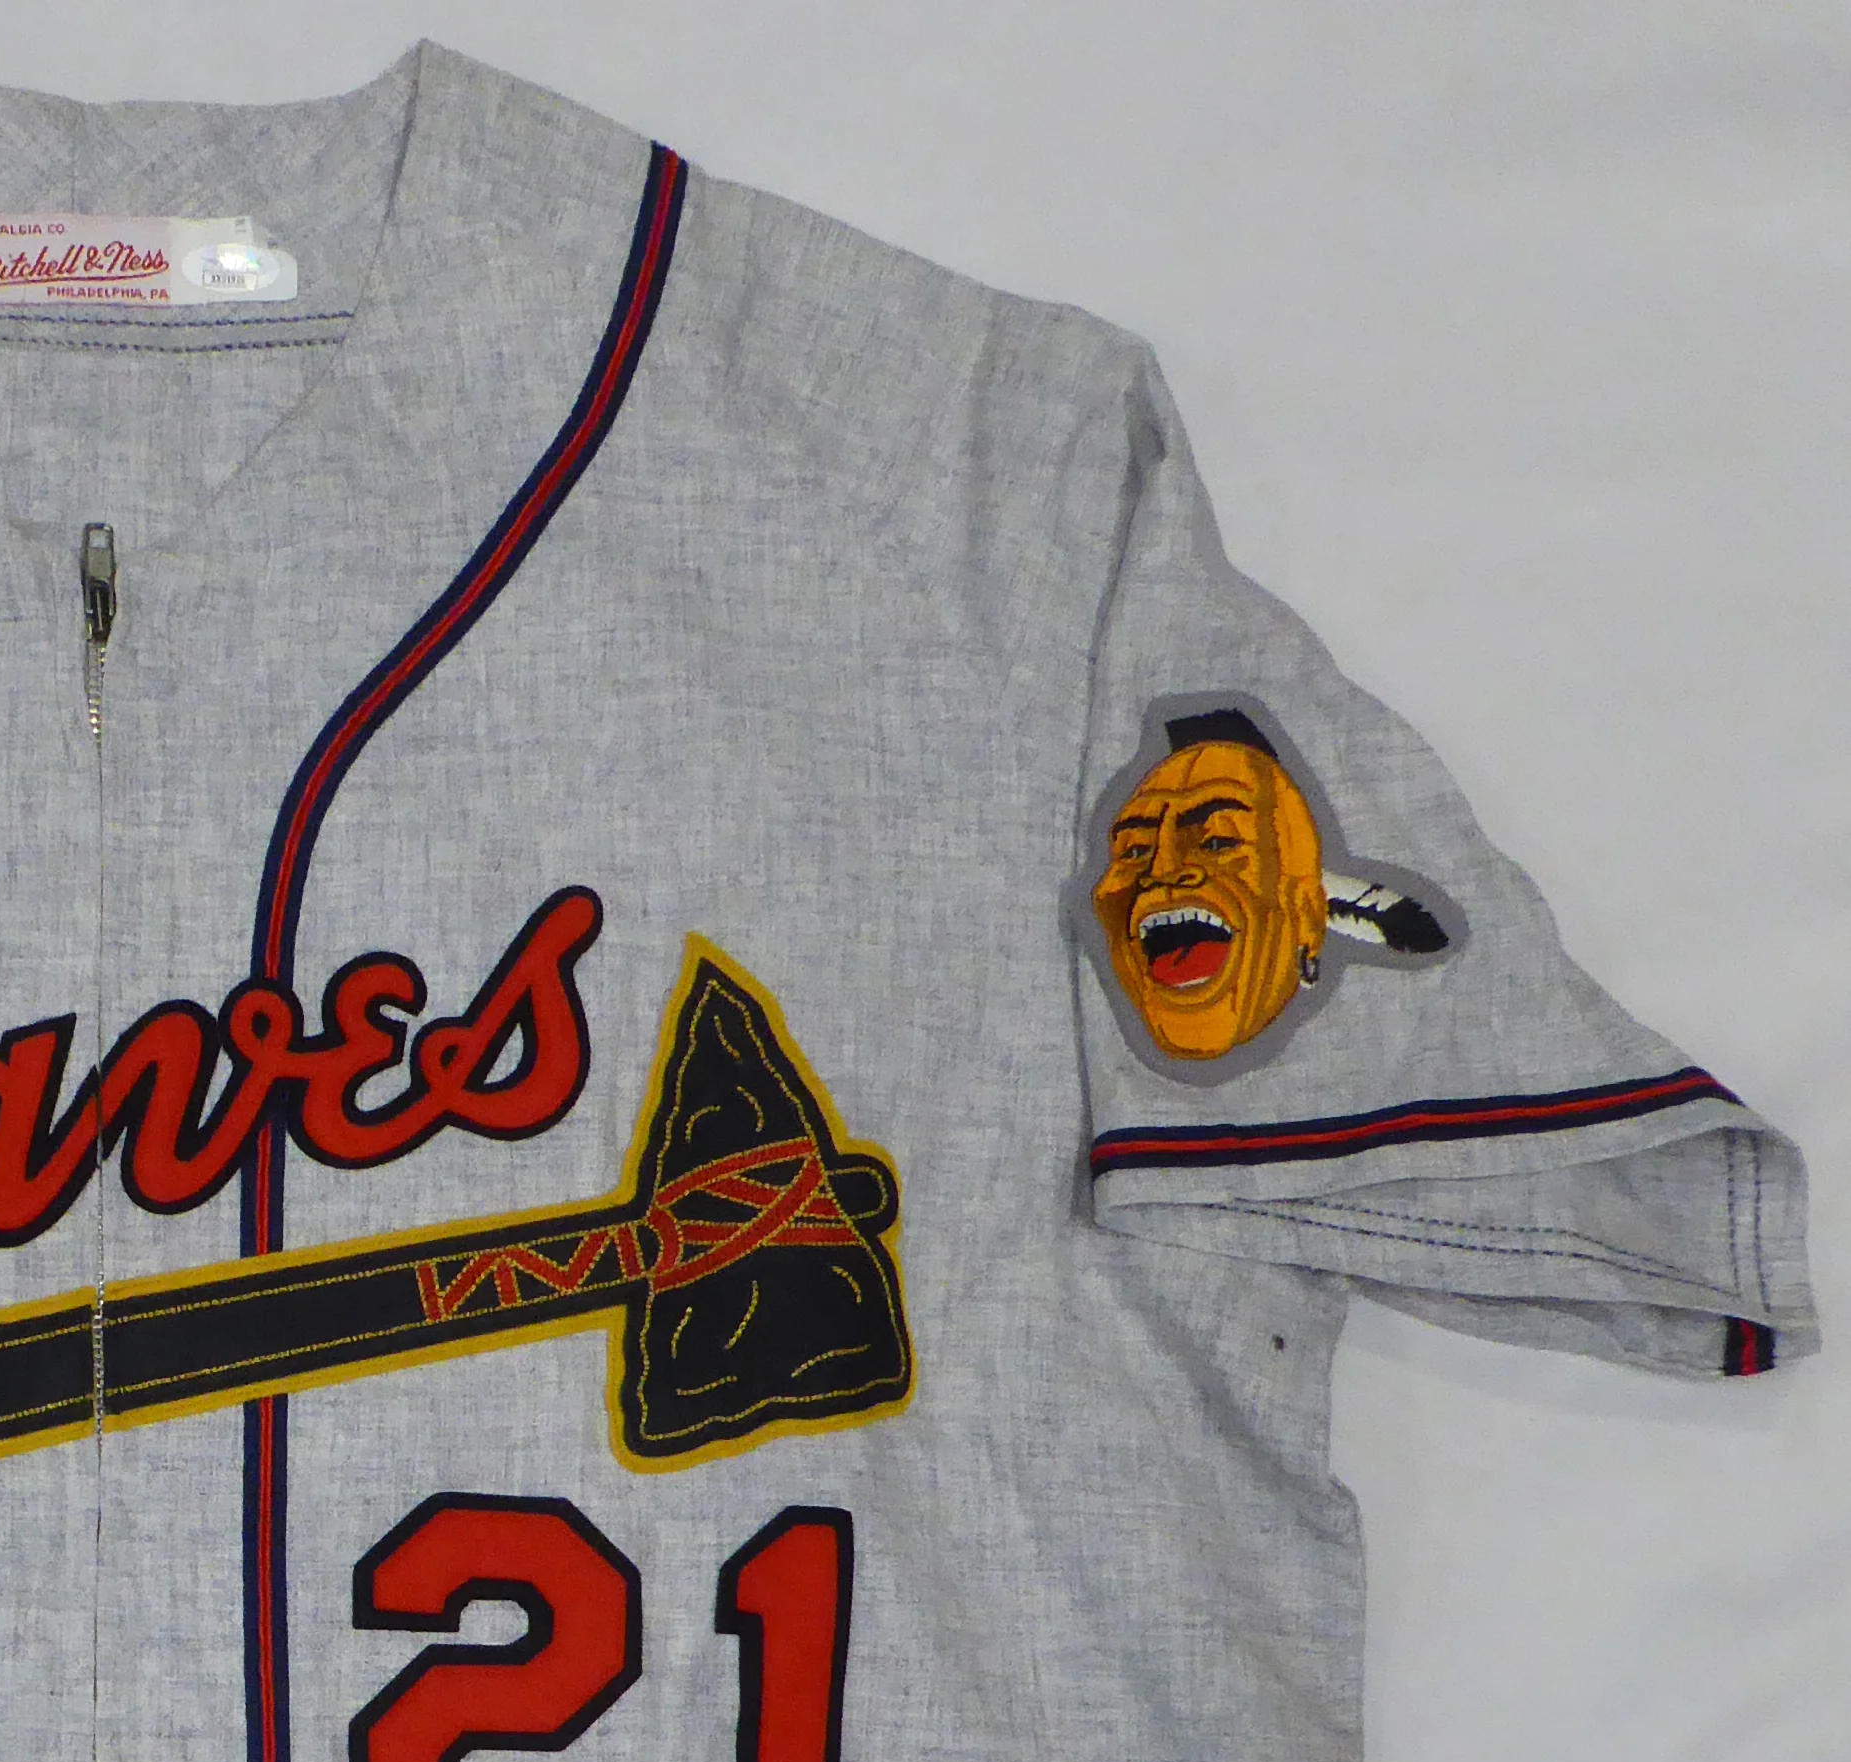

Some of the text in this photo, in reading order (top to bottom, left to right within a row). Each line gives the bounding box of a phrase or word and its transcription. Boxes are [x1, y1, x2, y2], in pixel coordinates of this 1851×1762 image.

[84, 245, 104, 273] &
[103, 240, 170, 273] Ness
[150, 288, 169, 300] PA
